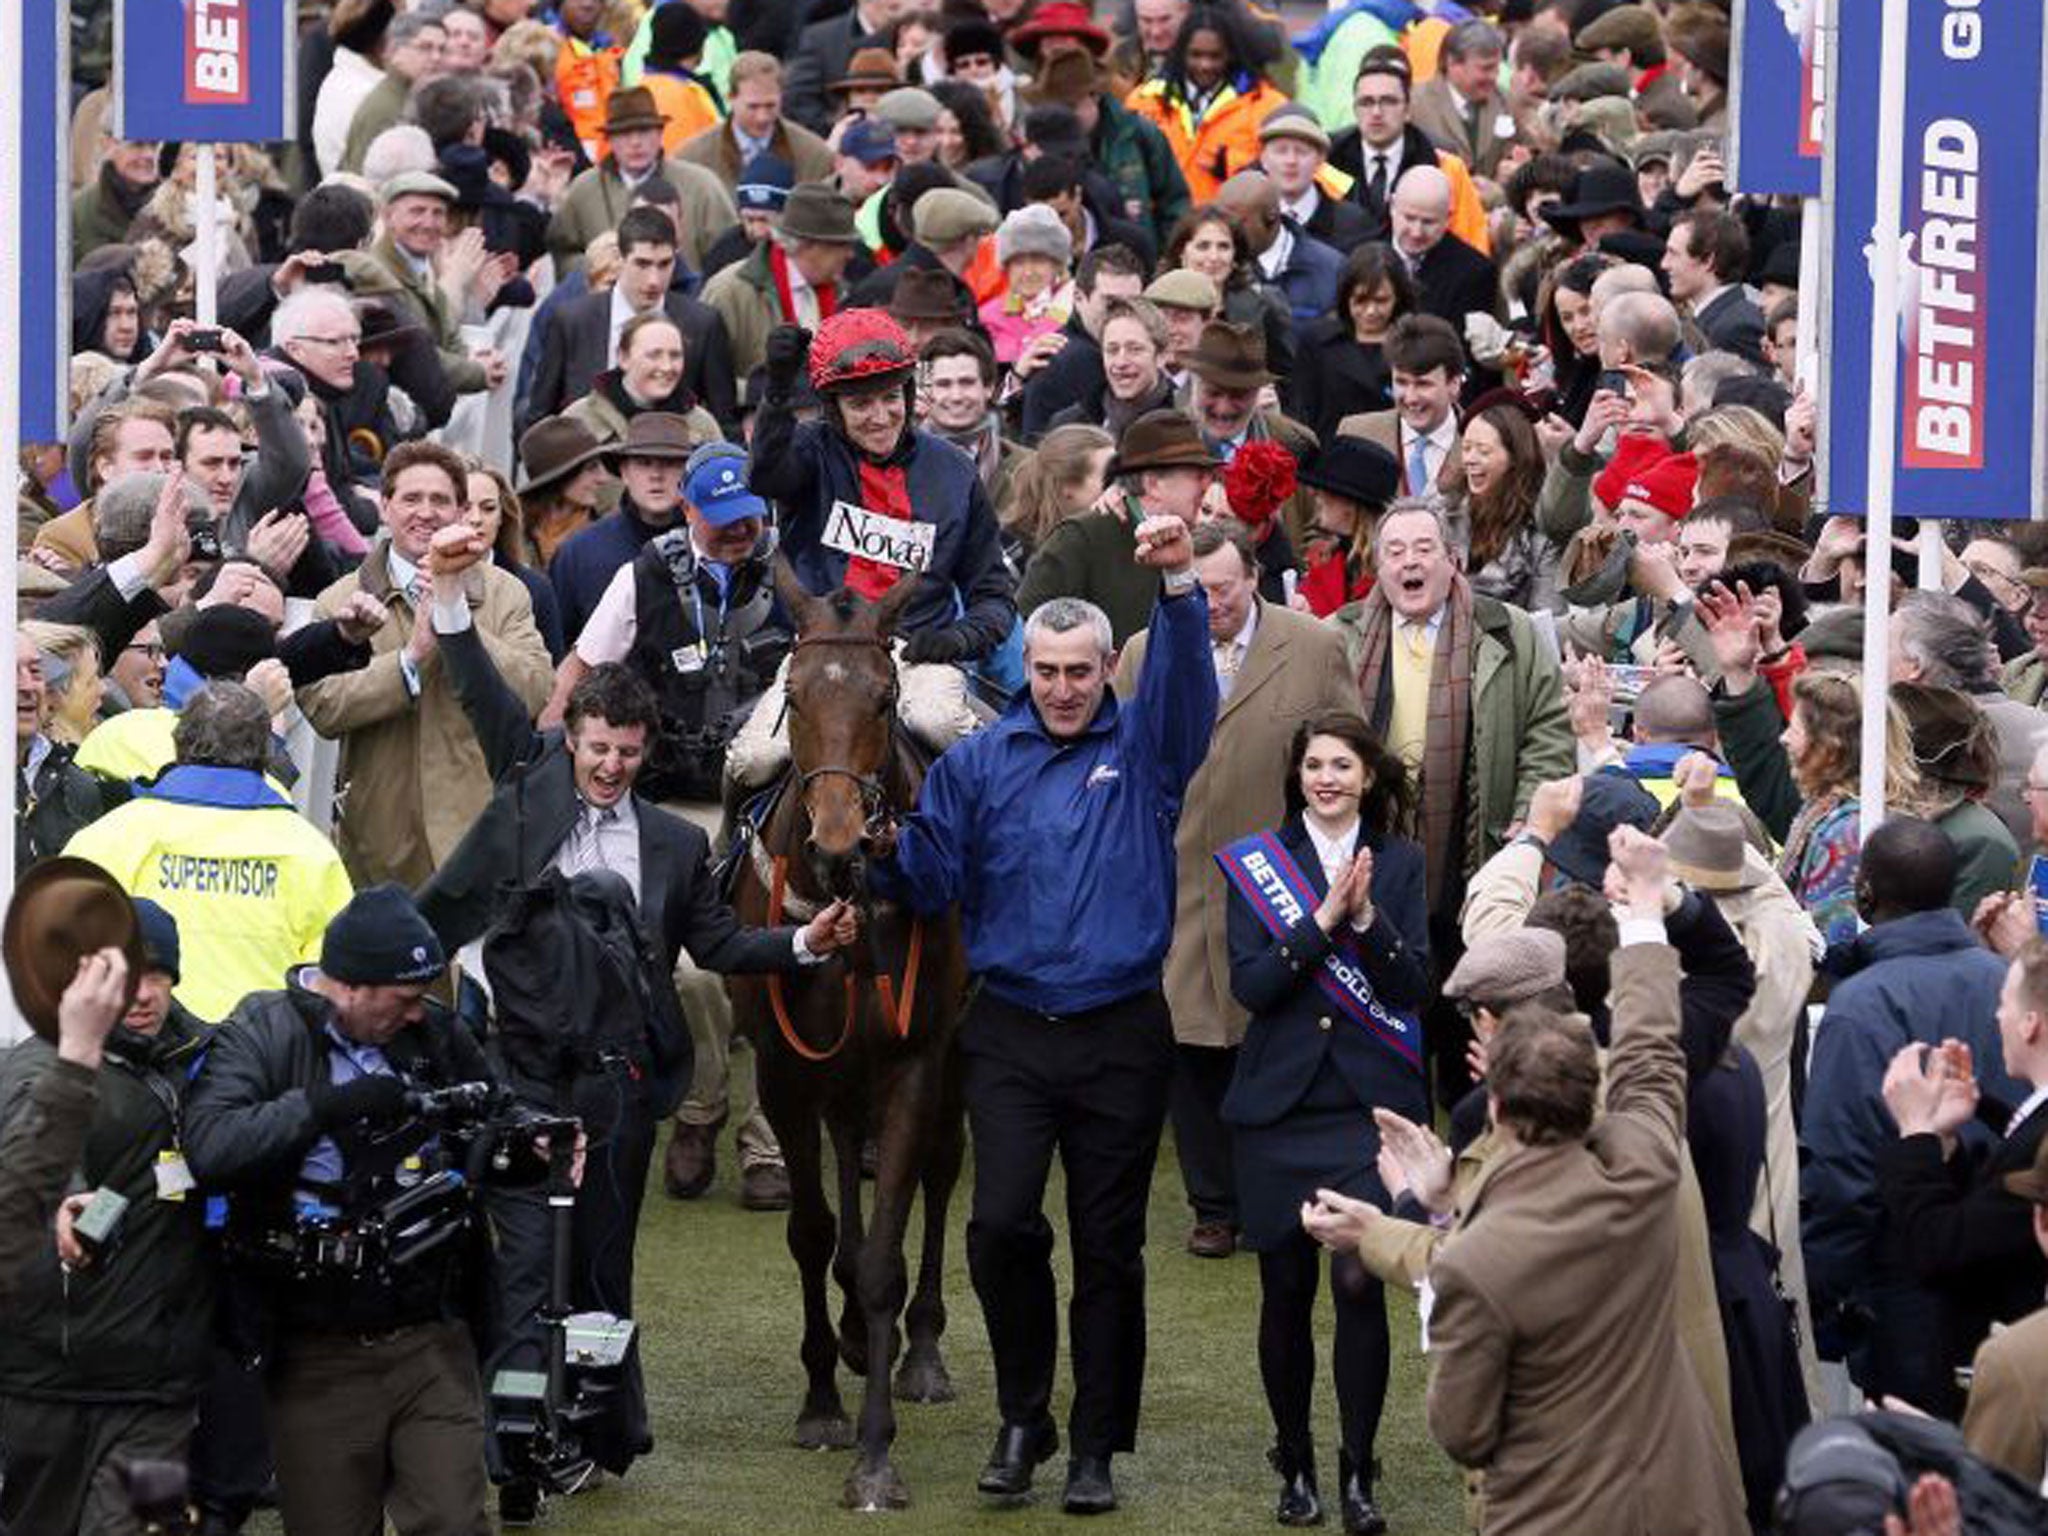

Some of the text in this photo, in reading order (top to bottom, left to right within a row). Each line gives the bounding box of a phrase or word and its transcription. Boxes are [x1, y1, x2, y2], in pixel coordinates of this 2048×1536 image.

[1942, 0, 1982, 60] G
[1916, 118, 1979, 456] BETFRED
[158, 853, 278, 899] SUPERVISOR
